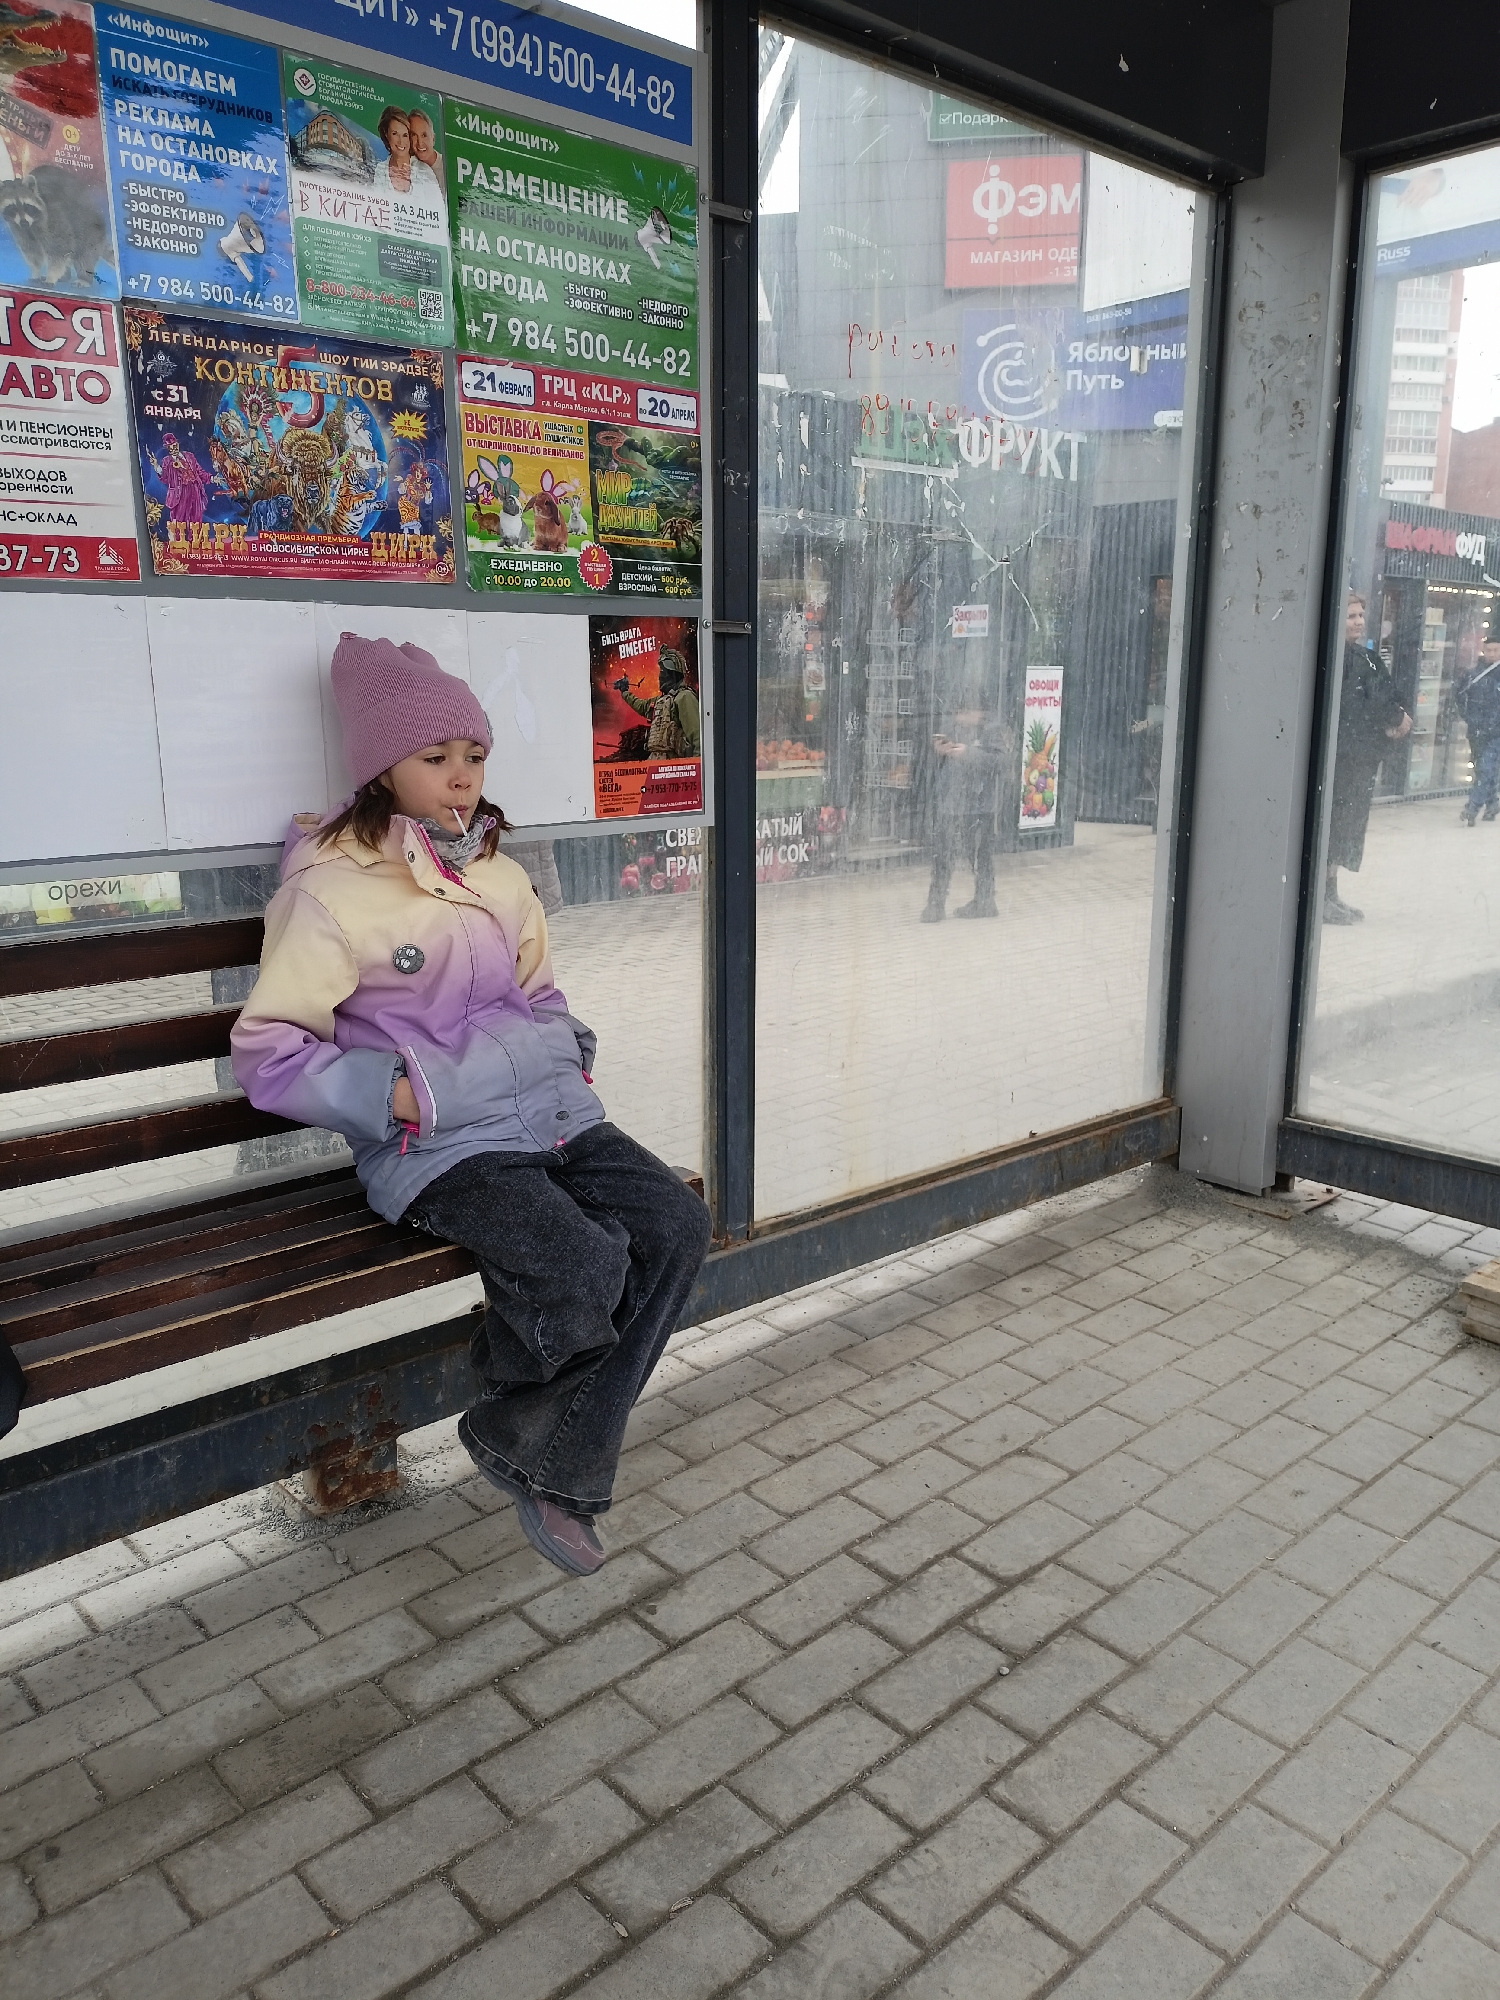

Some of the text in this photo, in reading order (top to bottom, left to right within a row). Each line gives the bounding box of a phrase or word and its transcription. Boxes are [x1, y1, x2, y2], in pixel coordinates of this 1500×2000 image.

[107, 14, 210, 49] «Инфощит»
[110, 48, 237, 97] ПОМОГАЕМ
[429, 6, 464, 51] +7
[470, 15, 542, 78] (984)
[548, 43, 676, 121] 500-44-82
[112, 75, 169, 99] ИСКАТЬ
[114, 98, 215, 139] РЕКЛАМА
[455, 113, 560, 153] «Инфощит»
[952, 112, 1013, 126] Подарк
[117, 125, 279, 176] НА ОСТАНОВКАХ
[119, 150, 202, 184] ГОРОДА
[299, 180, 390, 207] ПРОТЕЗИРОВАНИЕ ЗУБОВ
[456, 157, 629, 225] РАЗМЕЩЕНИЕ
[299, 189, 310, 212] В
[318, 194, 392, 230] КИТАЕ
[393, 202, 408, 215] ЗА
[416, 207, 440, 222] ДНЯ
[521, 211, 628, 251] ИНФОРМАЦИИ
[460, 226, 491, 255] НА
[496, 236, 632, 285] ОСТАНОВКАХ
[970, 246, 1078, 264] МАГАЗИН ОДЕ
[127, 273, 151, 293] +7
[157, 276, 195, 299] 984
[200, 281, 296, 316] 500-44-82
[461, 265, 548, 304] ГОРОДА
[148, 329, 429, 377] ЛЕГЕНДАРНОЕ ШОУ ГИИ ЭРАДЗЕ
[466, 313, 497, 343] +7
[508, 317, 557, 355] 984
[565, 326, 692, 377] 500-44-82
[1067, 341, 1187, 363] Яблоны
[0, 362, 111, 405] АВТО
[194, 355, 392, 401] КОНТИНЕНТОВ
[472, 369, 497, 393] 21
[498, 381, 532, 398] ФЕВРАЛЯ
[541, 374, 631, 405] ТРЦ «KLP»
[1066, 369, 1124, 395] Путь
[166, 385, 189, 404] 31
[145, 405, 201, 421] ЯНВАРЯ
[647, 397, 671, 419] 20
[671, 408, 695, 424] АПРЕЛЯ
[6, 420, 114, 439] И ПЕНСИОНЕРЫ
[464, 411, 542, 441] ВЫСТАВКА
[1, 434, 112, 451] ссматриваются
[466, 438, 477, 447] ОТ
[530, 445, 541, 455] ДО
[958, 417, 1088, 482] ФРУКТ
[596, 469, 631, 505] МИР
[598, 502, 657, 532] ДЖУНГЛЕЙ
[167, 521, 249, 556] ЦИРК
[251, 543, 370, 557] В НОВОСИБИРСКОМ ЦИРКЕ
[370, 531, 438, 562] ЦИРК
[1455, 532, 1487, 567] ФУД
[490, 558, 563, 573] ЕЖЕДНЕВНО
[590, 548, 599, 562] 2
[493, 574, 522, 586] 10.00
[523, 578, 538, 588] до
[540, 576, 571, 588] 20.00
[594, 573, 600, 585] 1
[618, 583, 657, 593] ВЗРОСЛЫЙ
[621, 572, 653, 582] ДЕТСКИЙ
[601, 627, 642, 647] БИТЬ ВРАГА
[618, 635, 656, 660] ВМЕСТЕ!
[1029, 679, 1059, 691] ОВОЩИ
[666, 827, 701, 848] СВЕ
[666, 843, 810, 878] ГРА СОК
[48, 879, 122, 905] орехи
